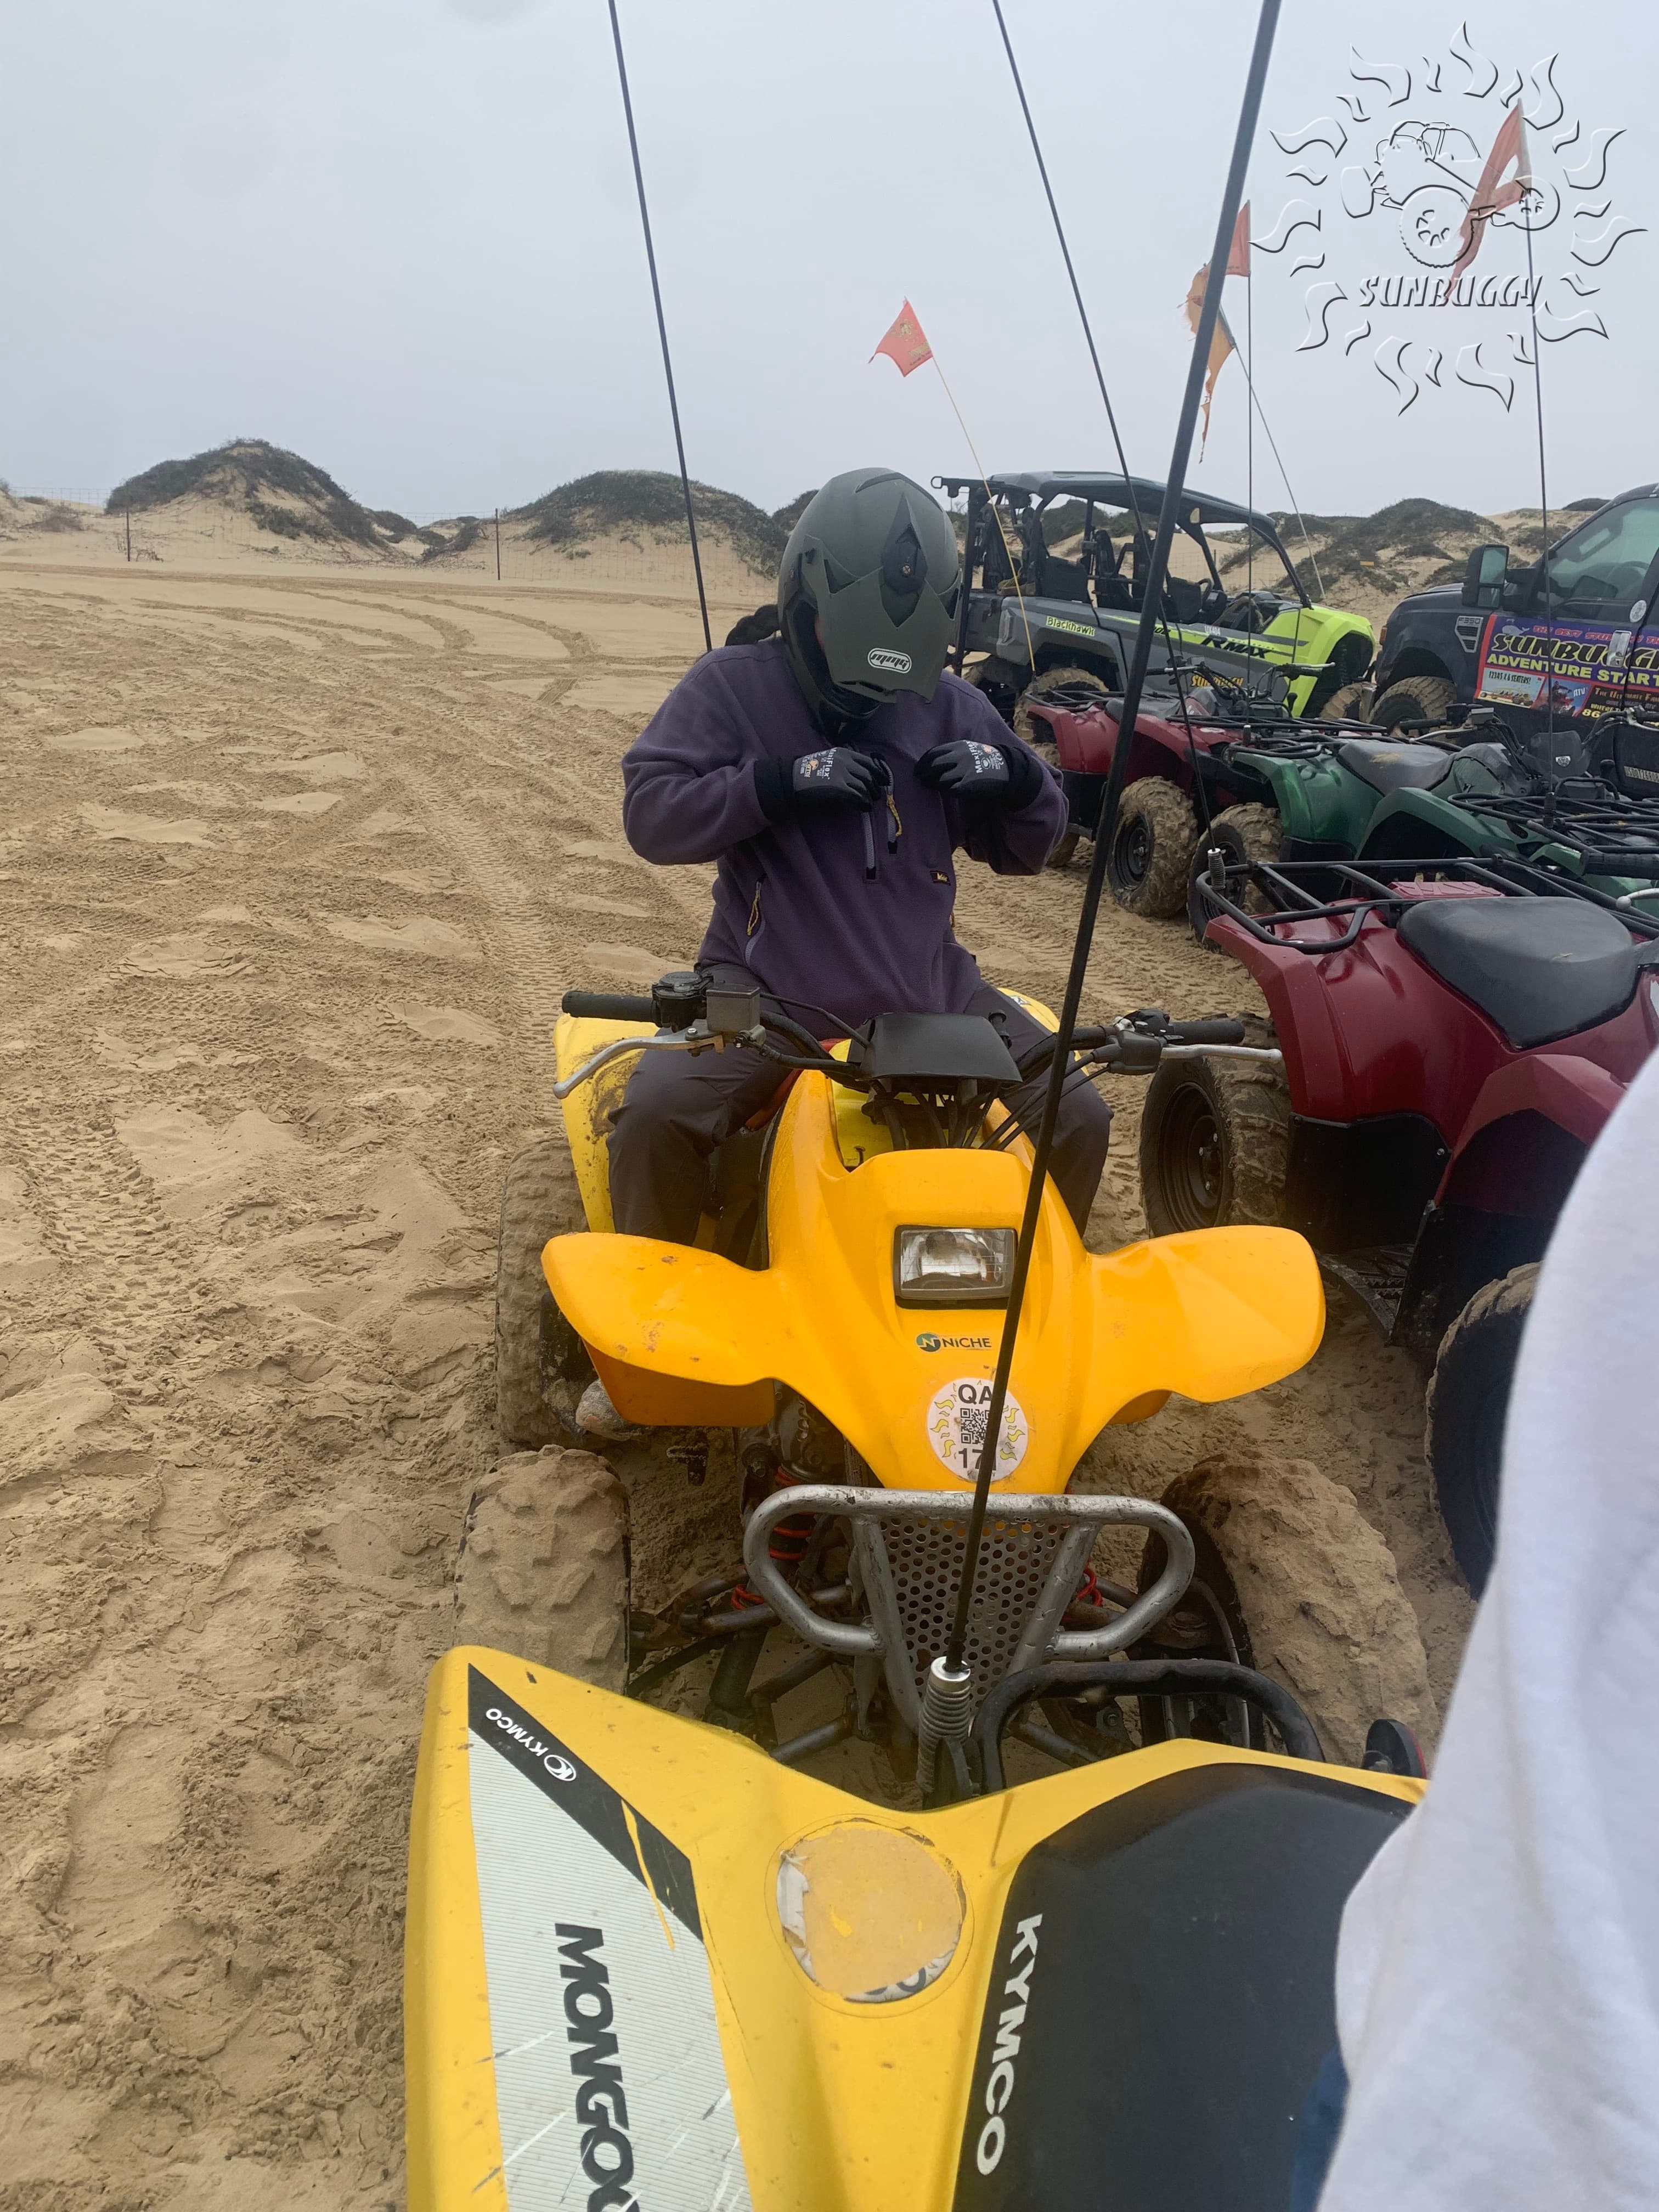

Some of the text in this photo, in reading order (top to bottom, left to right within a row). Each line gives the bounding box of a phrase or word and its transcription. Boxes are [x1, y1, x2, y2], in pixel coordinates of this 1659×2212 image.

[1048, 617, 1094, 635] Blackhawk
[1487, 653, 1592, 679] ADVENTURE
[1573, 687, 1585, 697] ATV
[958, 1448, 996, 1471] 17
[486, 1708, 549, 1757] KYMCO
[977, 1913, 1043, 2175] KYMCO
